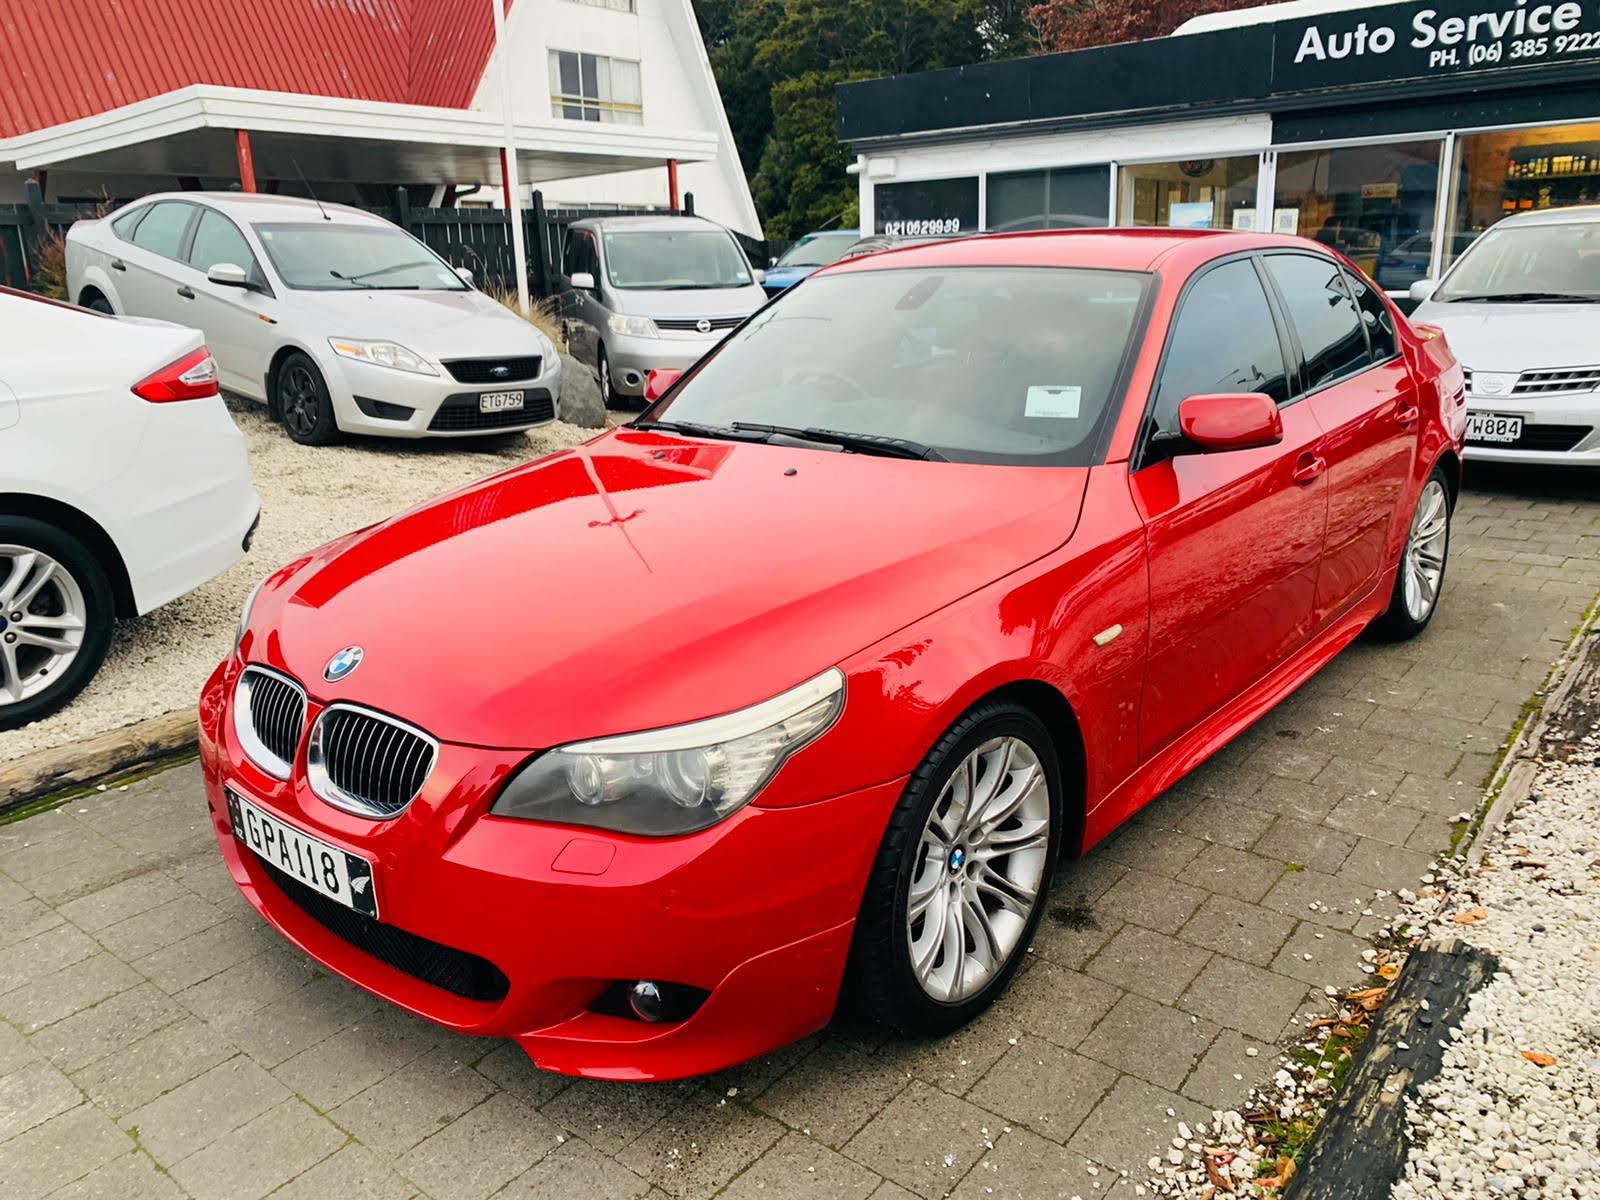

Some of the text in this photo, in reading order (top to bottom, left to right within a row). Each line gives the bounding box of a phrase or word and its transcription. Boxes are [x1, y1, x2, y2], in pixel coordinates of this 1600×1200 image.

[1294, 0, 1582, 63] Auto Service
[1429, 48, 1461, 68] PH.
[1468, 40, 1503, 65] (06)
[1509, 37, 1549, 59] 385
[481, 392, 523, 409] ETG759
[246, 808, 340, 894] GPA118
